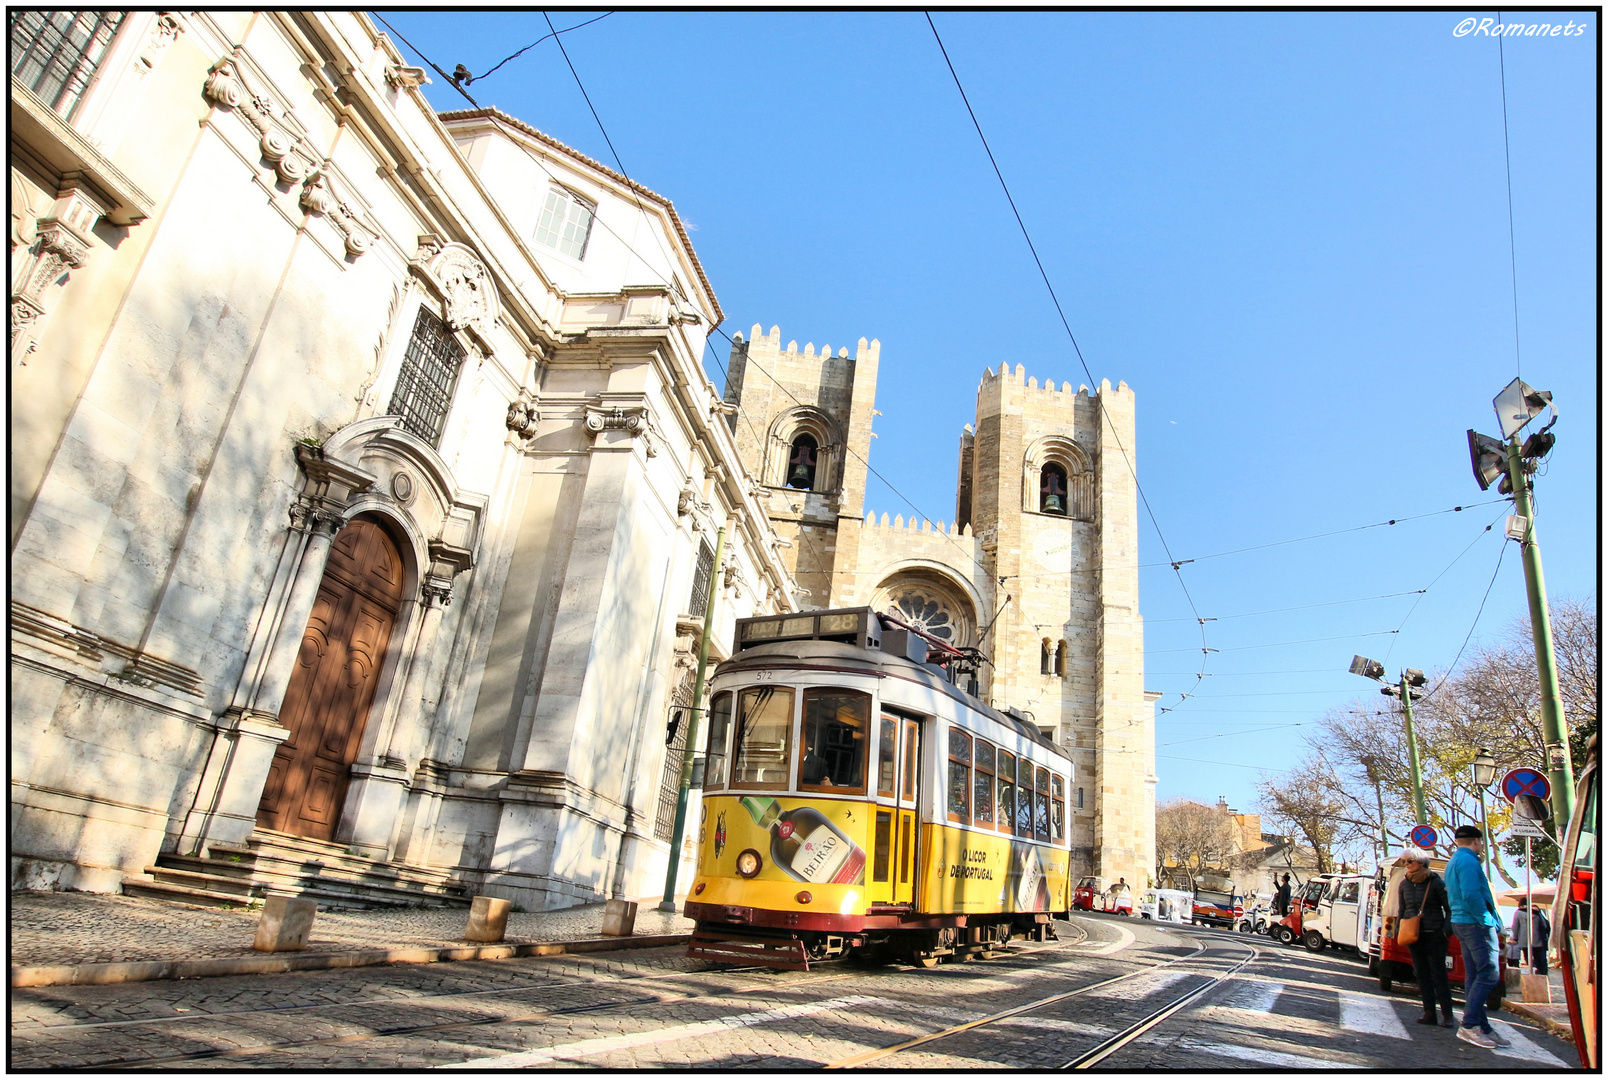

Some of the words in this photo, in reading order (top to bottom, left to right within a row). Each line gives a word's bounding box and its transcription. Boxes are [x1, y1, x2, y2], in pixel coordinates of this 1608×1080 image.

[829, 613, 854, 631] 28
[756, 671, 773, 680] 572
[803, 836, 837, 877] BEIRÃO
[962, 848, 968, 862] O
[968, 849, 987, 863] LICOR
[950, 864, 960, 879] DE
[960, 865, 993, 881] PORTUGAL
